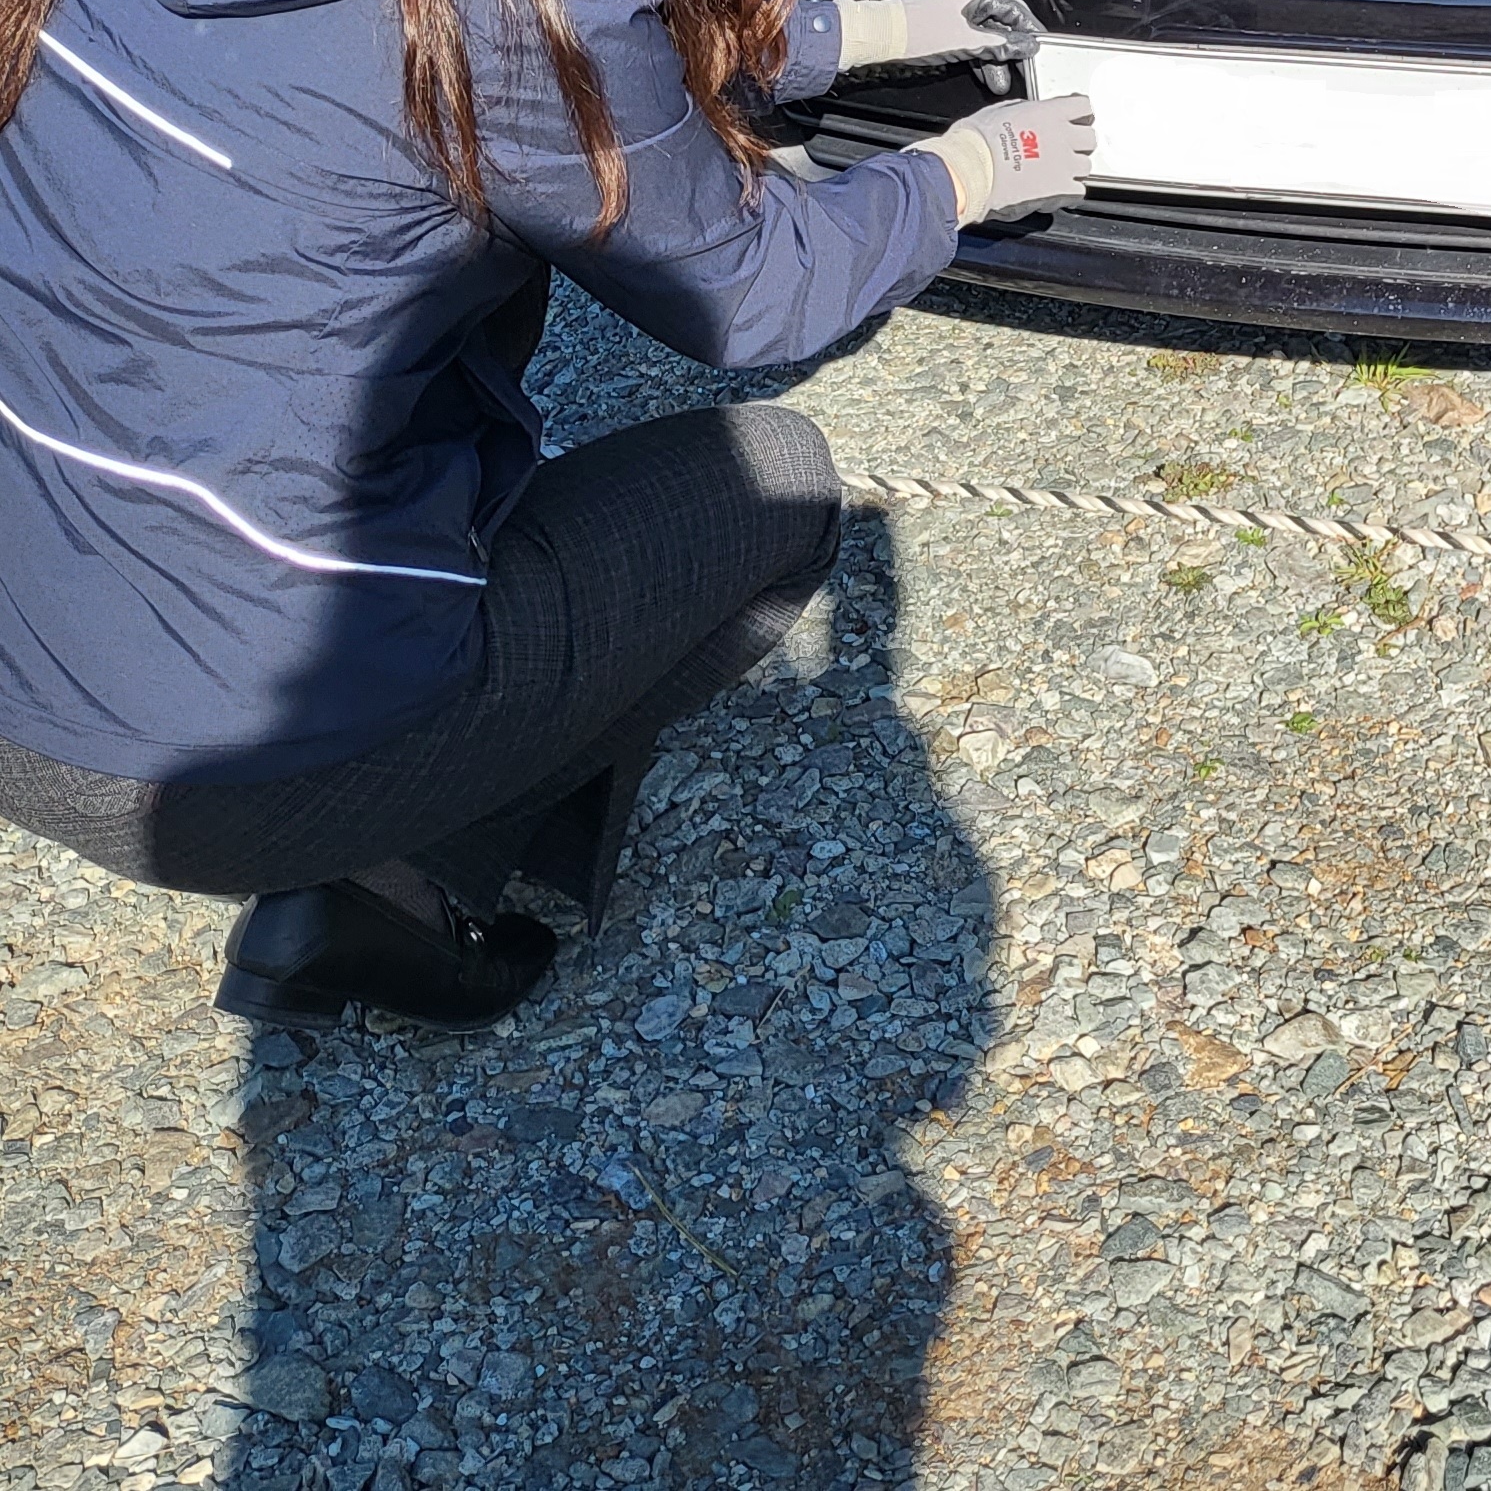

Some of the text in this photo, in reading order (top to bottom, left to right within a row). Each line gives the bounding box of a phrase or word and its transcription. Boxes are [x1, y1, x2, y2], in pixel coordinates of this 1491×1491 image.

[999, 133, 1010, 161] Gloves
[1002, 121, 1022, 172] Comfort Grip
[1019, 130, 1040, 159] 3M
